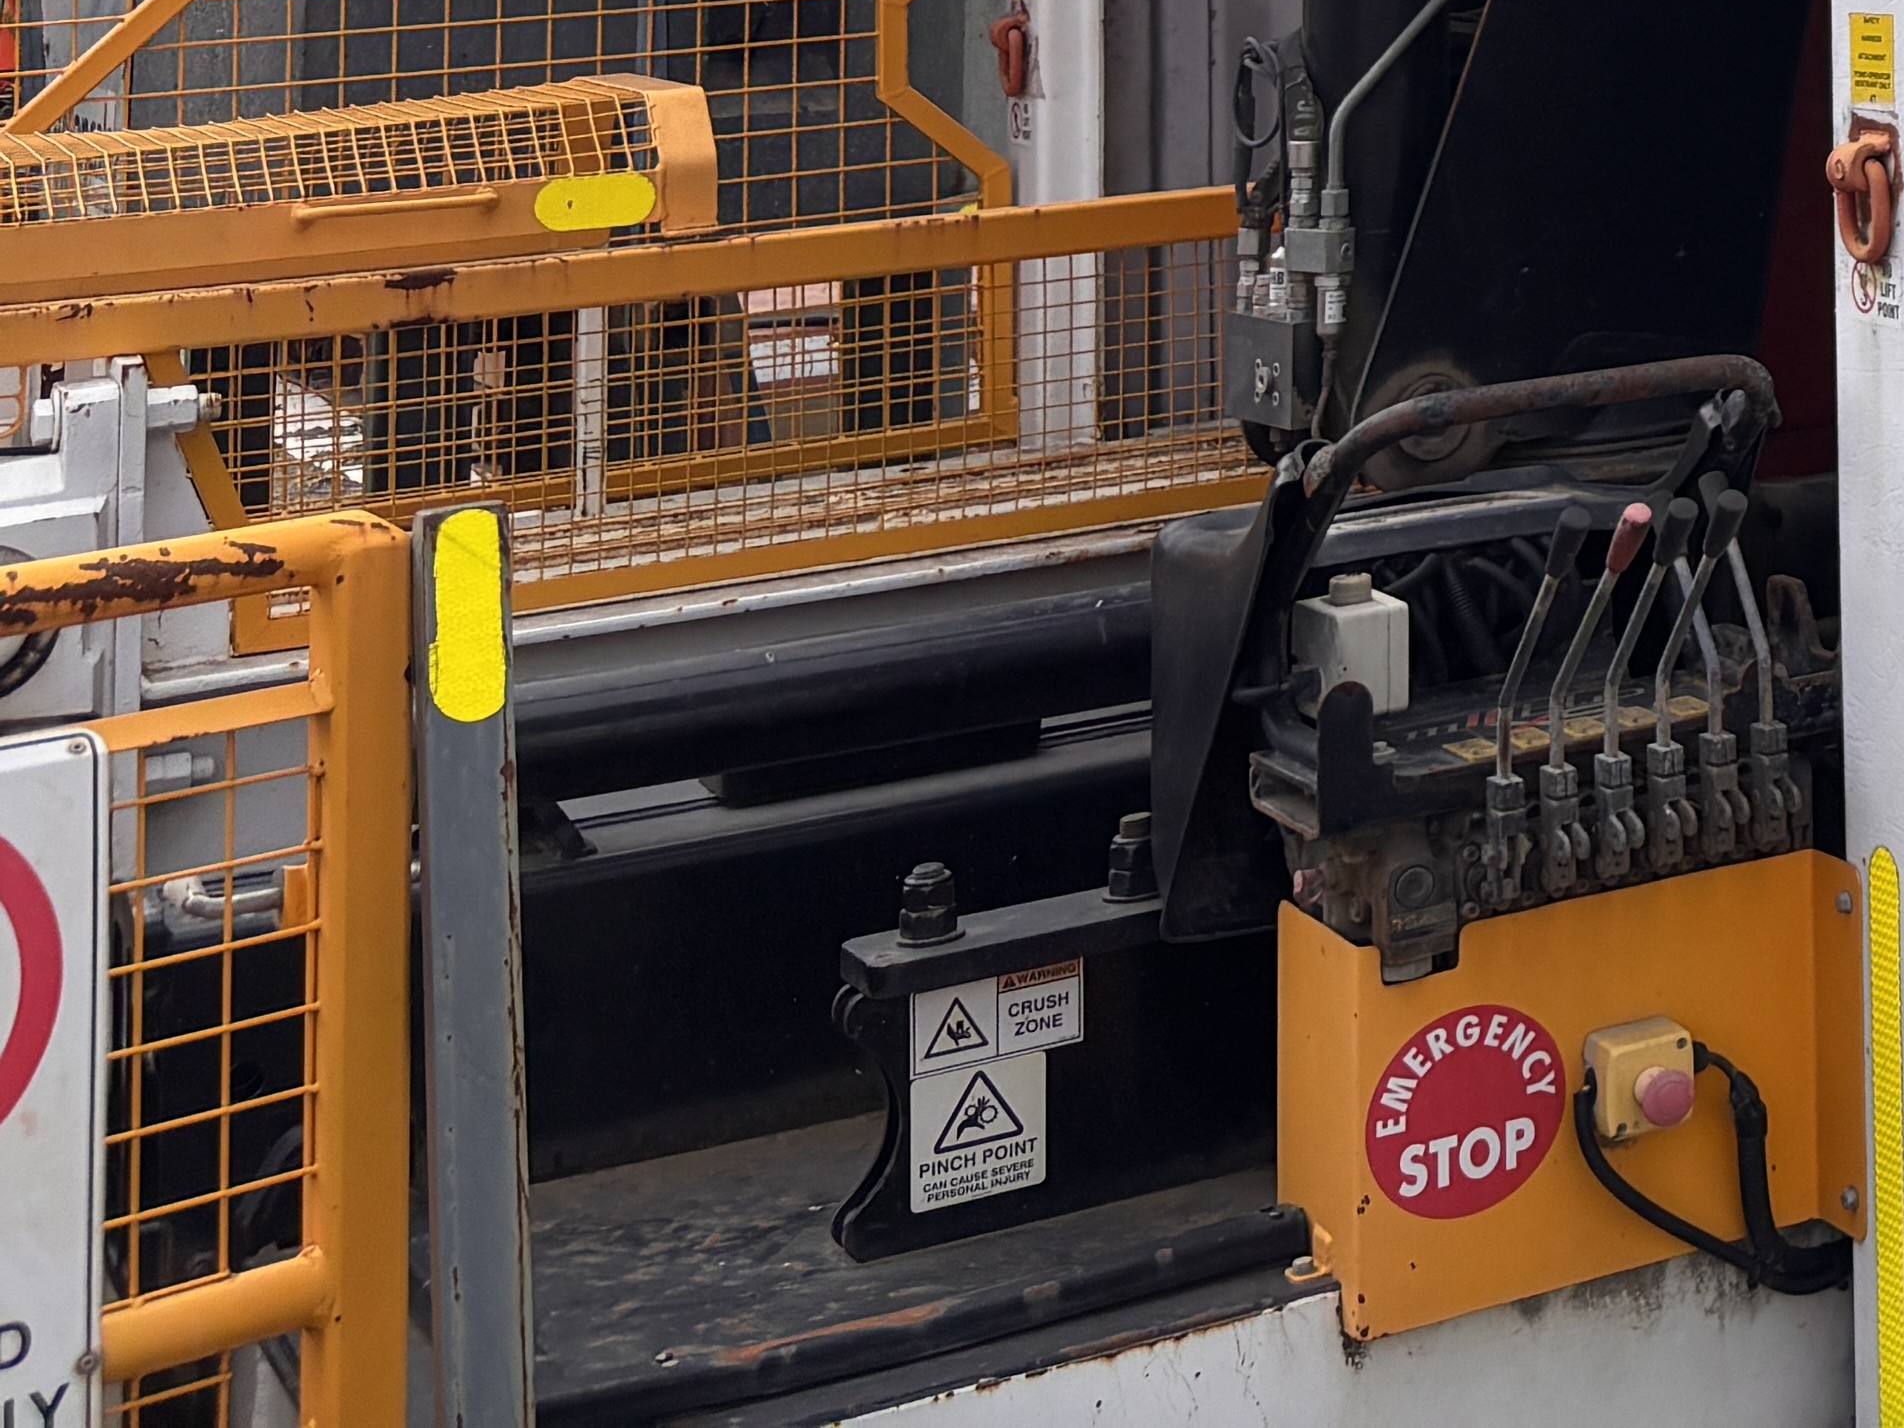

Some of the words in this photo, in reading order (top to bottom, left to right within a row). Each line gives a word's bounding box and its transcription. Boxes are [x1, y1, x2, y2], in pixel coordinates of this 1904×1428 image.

[1881, 282, 1896, 300] LIFT
[1878, 302, 1899, 319] POINT
[1017, 963, 1076, 984] WARNING
[1008, 991, 1069, 1017] CRUSH
[1014, 1013, 1063, 1036] ZONE
[1376, 1014, 1556, 1138] EMERGENCY
[919, 1152, 976, 1179] PINCH
[983, 1137, 1038, 1164] POINT
[1399, 1117, 1535, 1198] STOP
[923, 1180, 947, 1193] CAN
[950, 1170, 988, 1187] CAUSE
[991, 1158, 1034, 1177] SEVERE
[927, 1182, 988, 1203] PERSONAL
[991, 1170, 1031, 1188] INJURY
